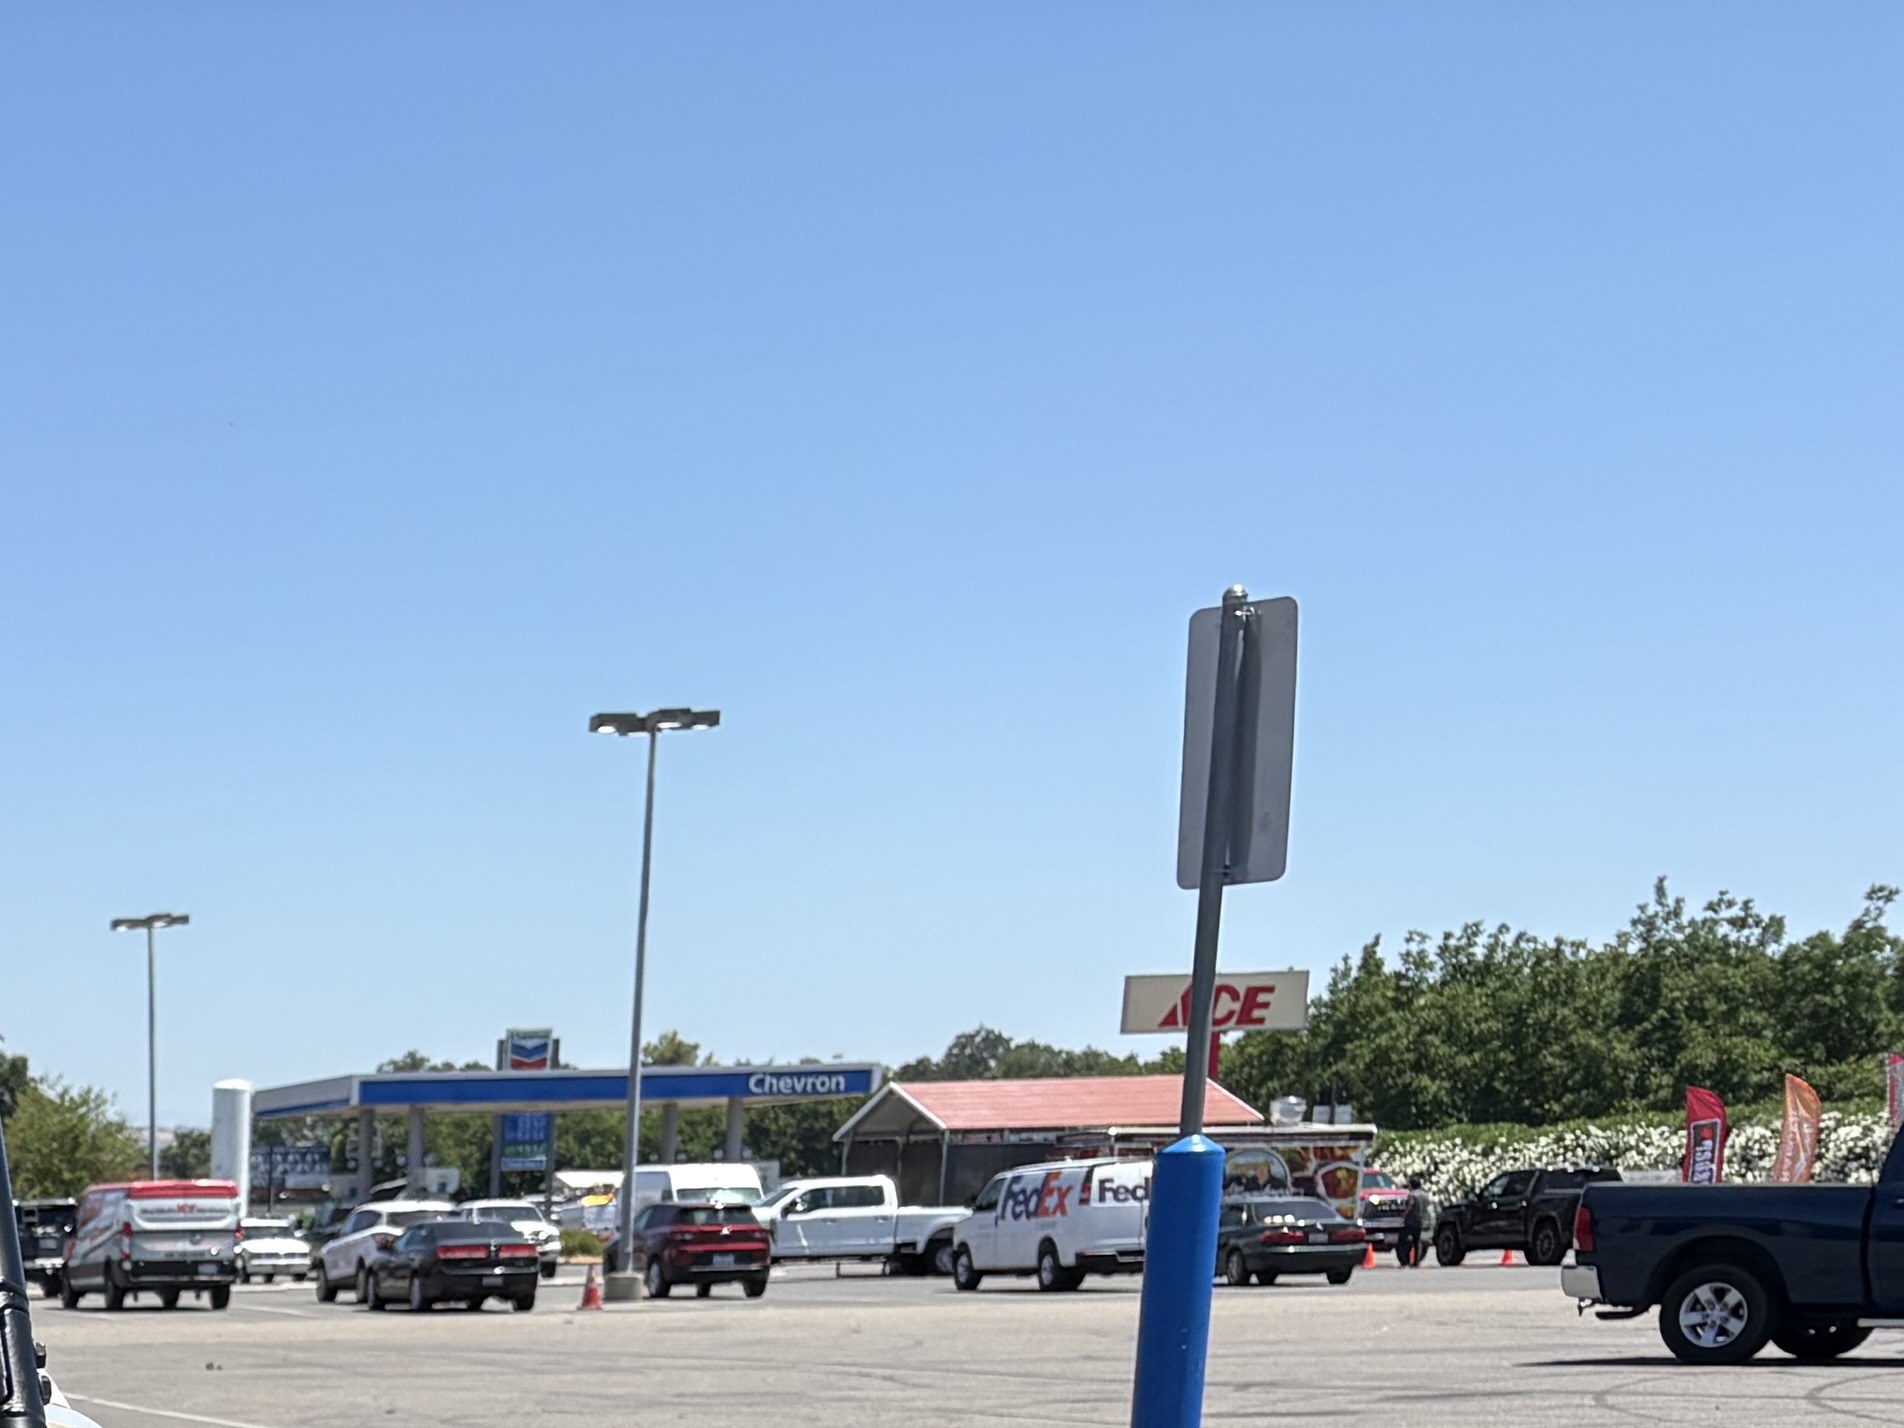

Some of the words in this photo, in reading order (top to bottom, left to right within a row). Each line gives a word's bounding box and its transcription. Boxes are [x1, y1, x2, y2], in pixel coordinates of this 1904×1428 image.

[748, 1074, 846, 1095] Chevron
[998, 1171, 1075, 1222] FedEx
[1098, 1176, 1150, 1204] Fed
